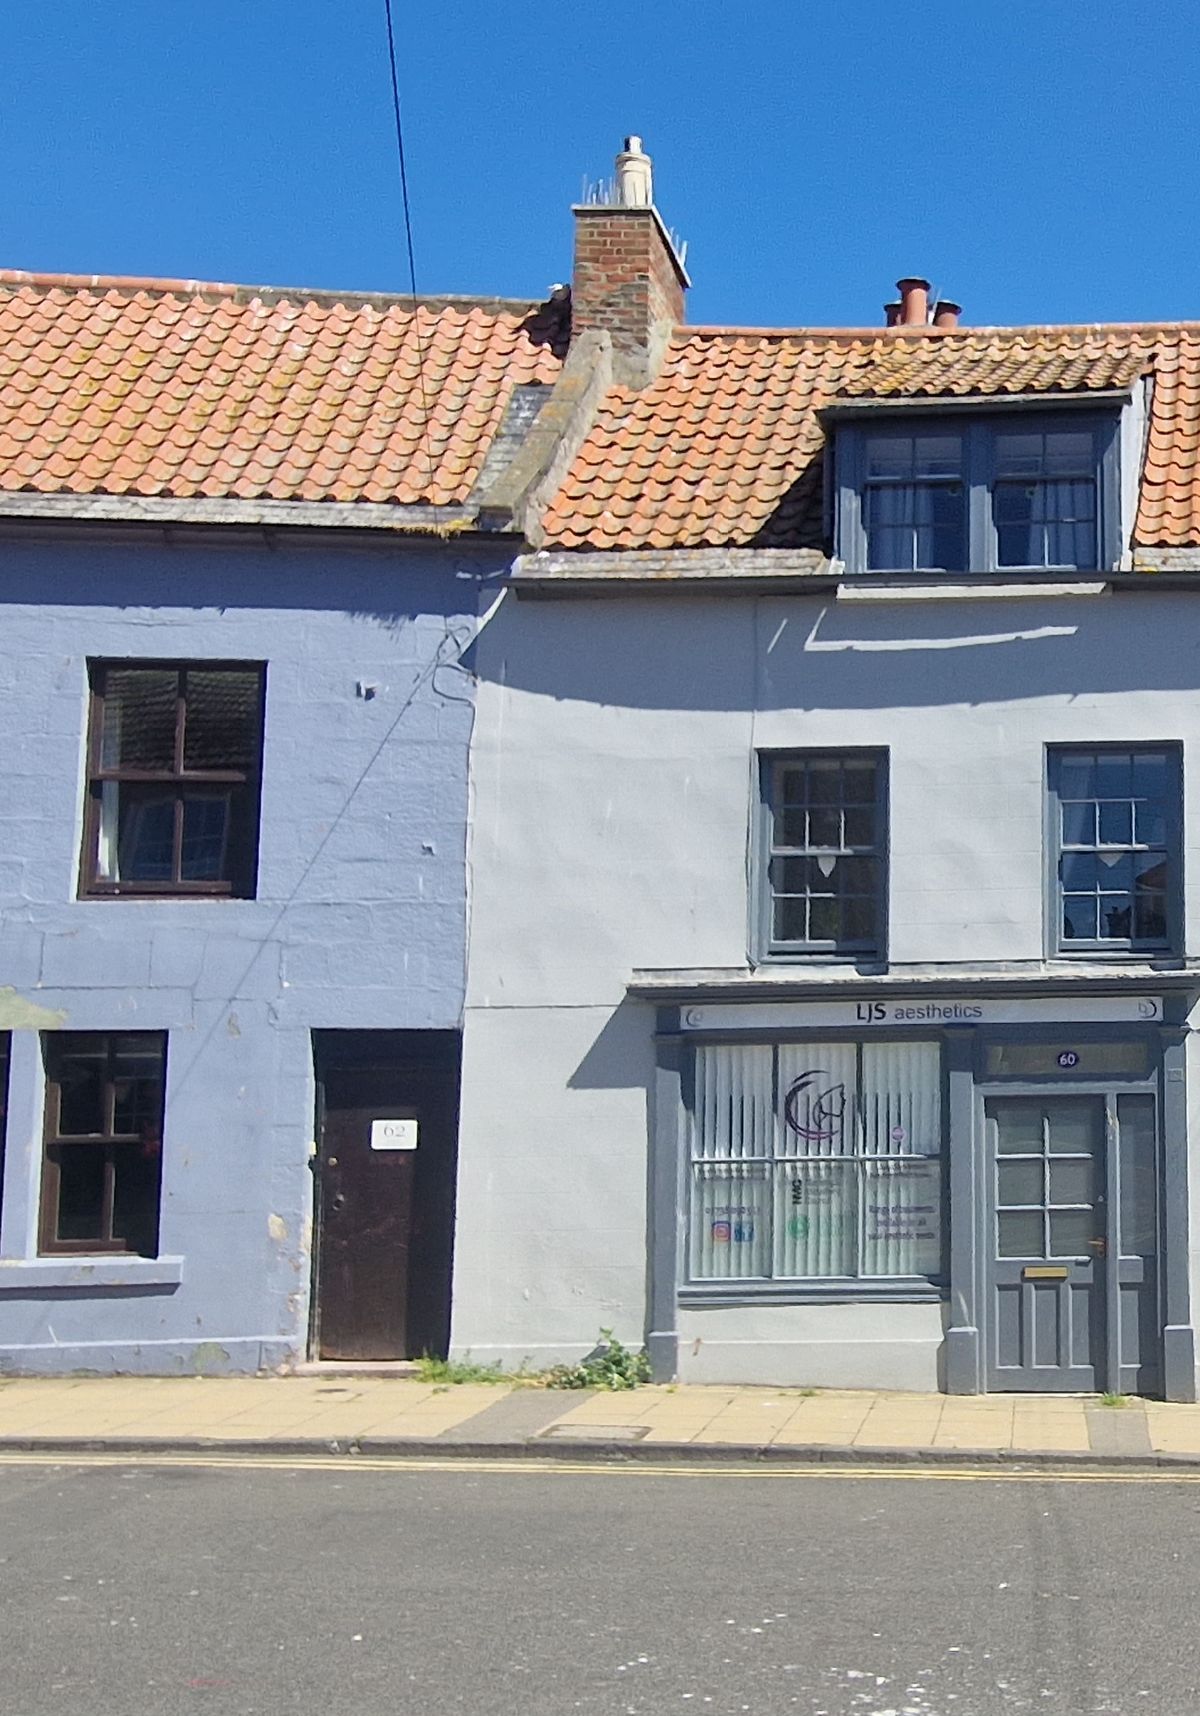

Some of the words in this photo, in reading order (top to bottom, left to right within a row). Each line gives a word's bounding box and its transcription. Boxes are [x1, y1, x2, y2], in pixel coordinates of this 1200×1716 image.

[856, 1003, 886, 1022] LJS
[894, 1004, 982, 1019] aesthetics
[1060, 1053, 1075, 1065] 60
[384, 1124, 405, 1137] 62
